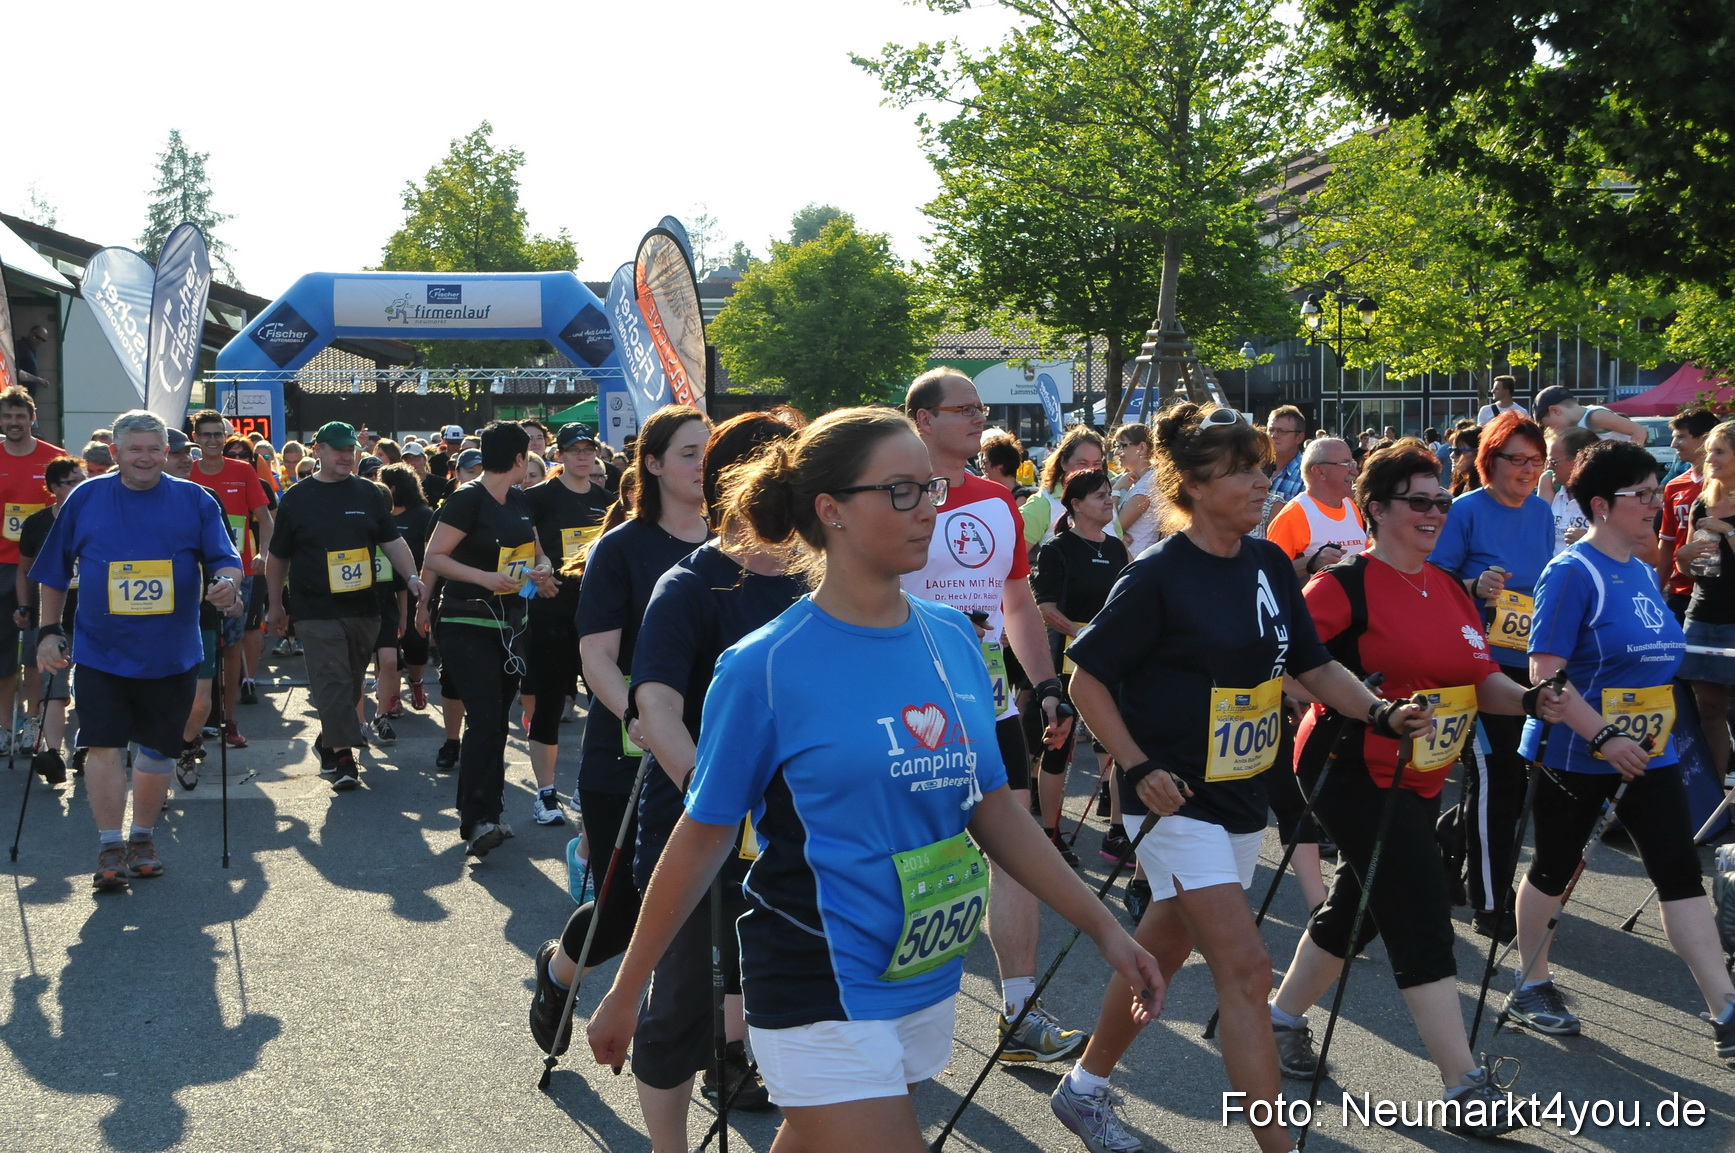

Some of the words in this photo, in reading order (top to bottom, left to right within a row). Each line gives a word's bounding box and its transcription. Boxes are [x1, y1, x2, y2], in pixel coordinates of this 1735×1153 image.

[170, 251, 199, 371] Fischer
[415, 305, 491, 319] firmenlauf
[266, 329, 308, 339] Fischer
[341, 563, 363, 581] 84
[508, 561, 527, 580] 77
[119, 579, 163, 601] 129
[926, 579, 965, 589] LAUFEN
[969, 579, 985, 588] MIT
[935, 593, 947, 601] Dr.
[973, 592, 983, 600] Dr.
[1502, 612, 1532, 637] 69
[1640, 653, 1676, 663] Formenbau
[877, 716, 905, 757] I
[1214, 711, 1279, 758] 1060
[890, 748, 978, 778] camping
[903, 852, 930, 873] 2014
[898, 895, 983, 966] 5050
